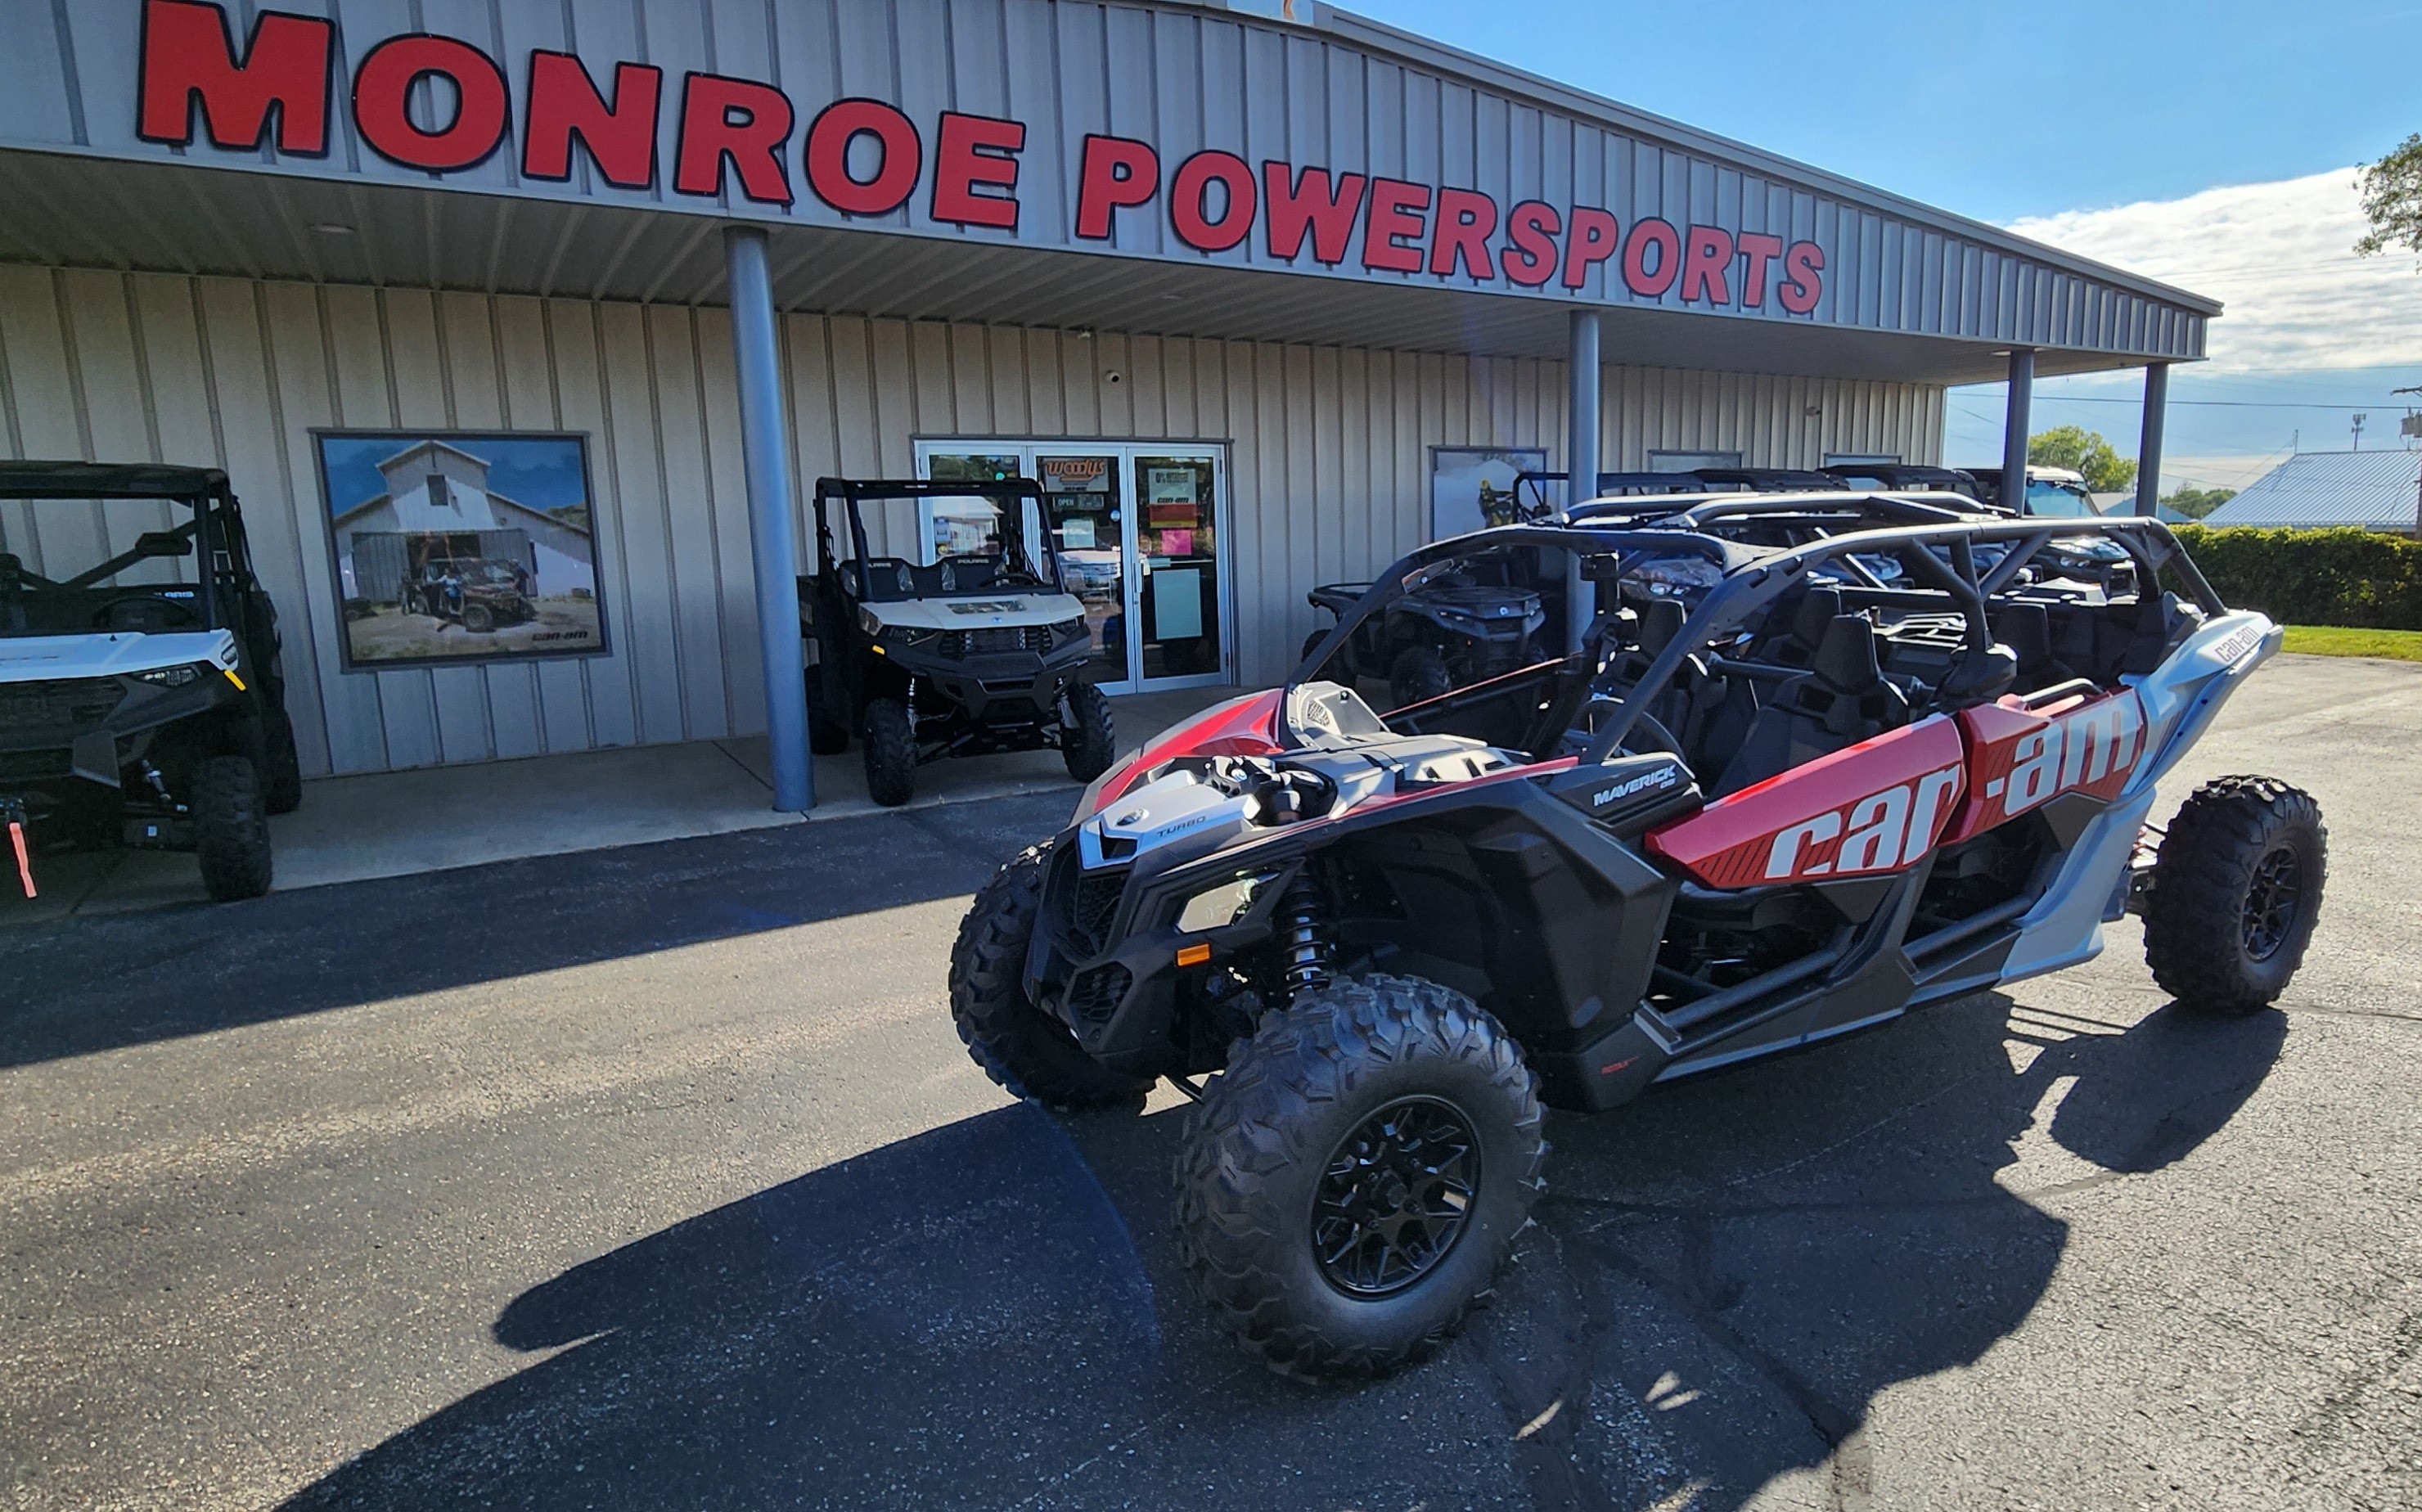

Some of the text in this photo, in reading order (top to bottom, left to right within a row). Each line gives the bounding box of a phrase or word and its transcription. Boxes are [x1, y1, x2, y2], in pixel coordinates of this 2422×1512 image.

[137, 0, 1826, 314] MONROE POWERSPORTS
[2214, 625, 2260, 663] can-am
[1592, 763, 1677, 807] MAVERICK
[1157, 816, 1206, 837] TURBO
